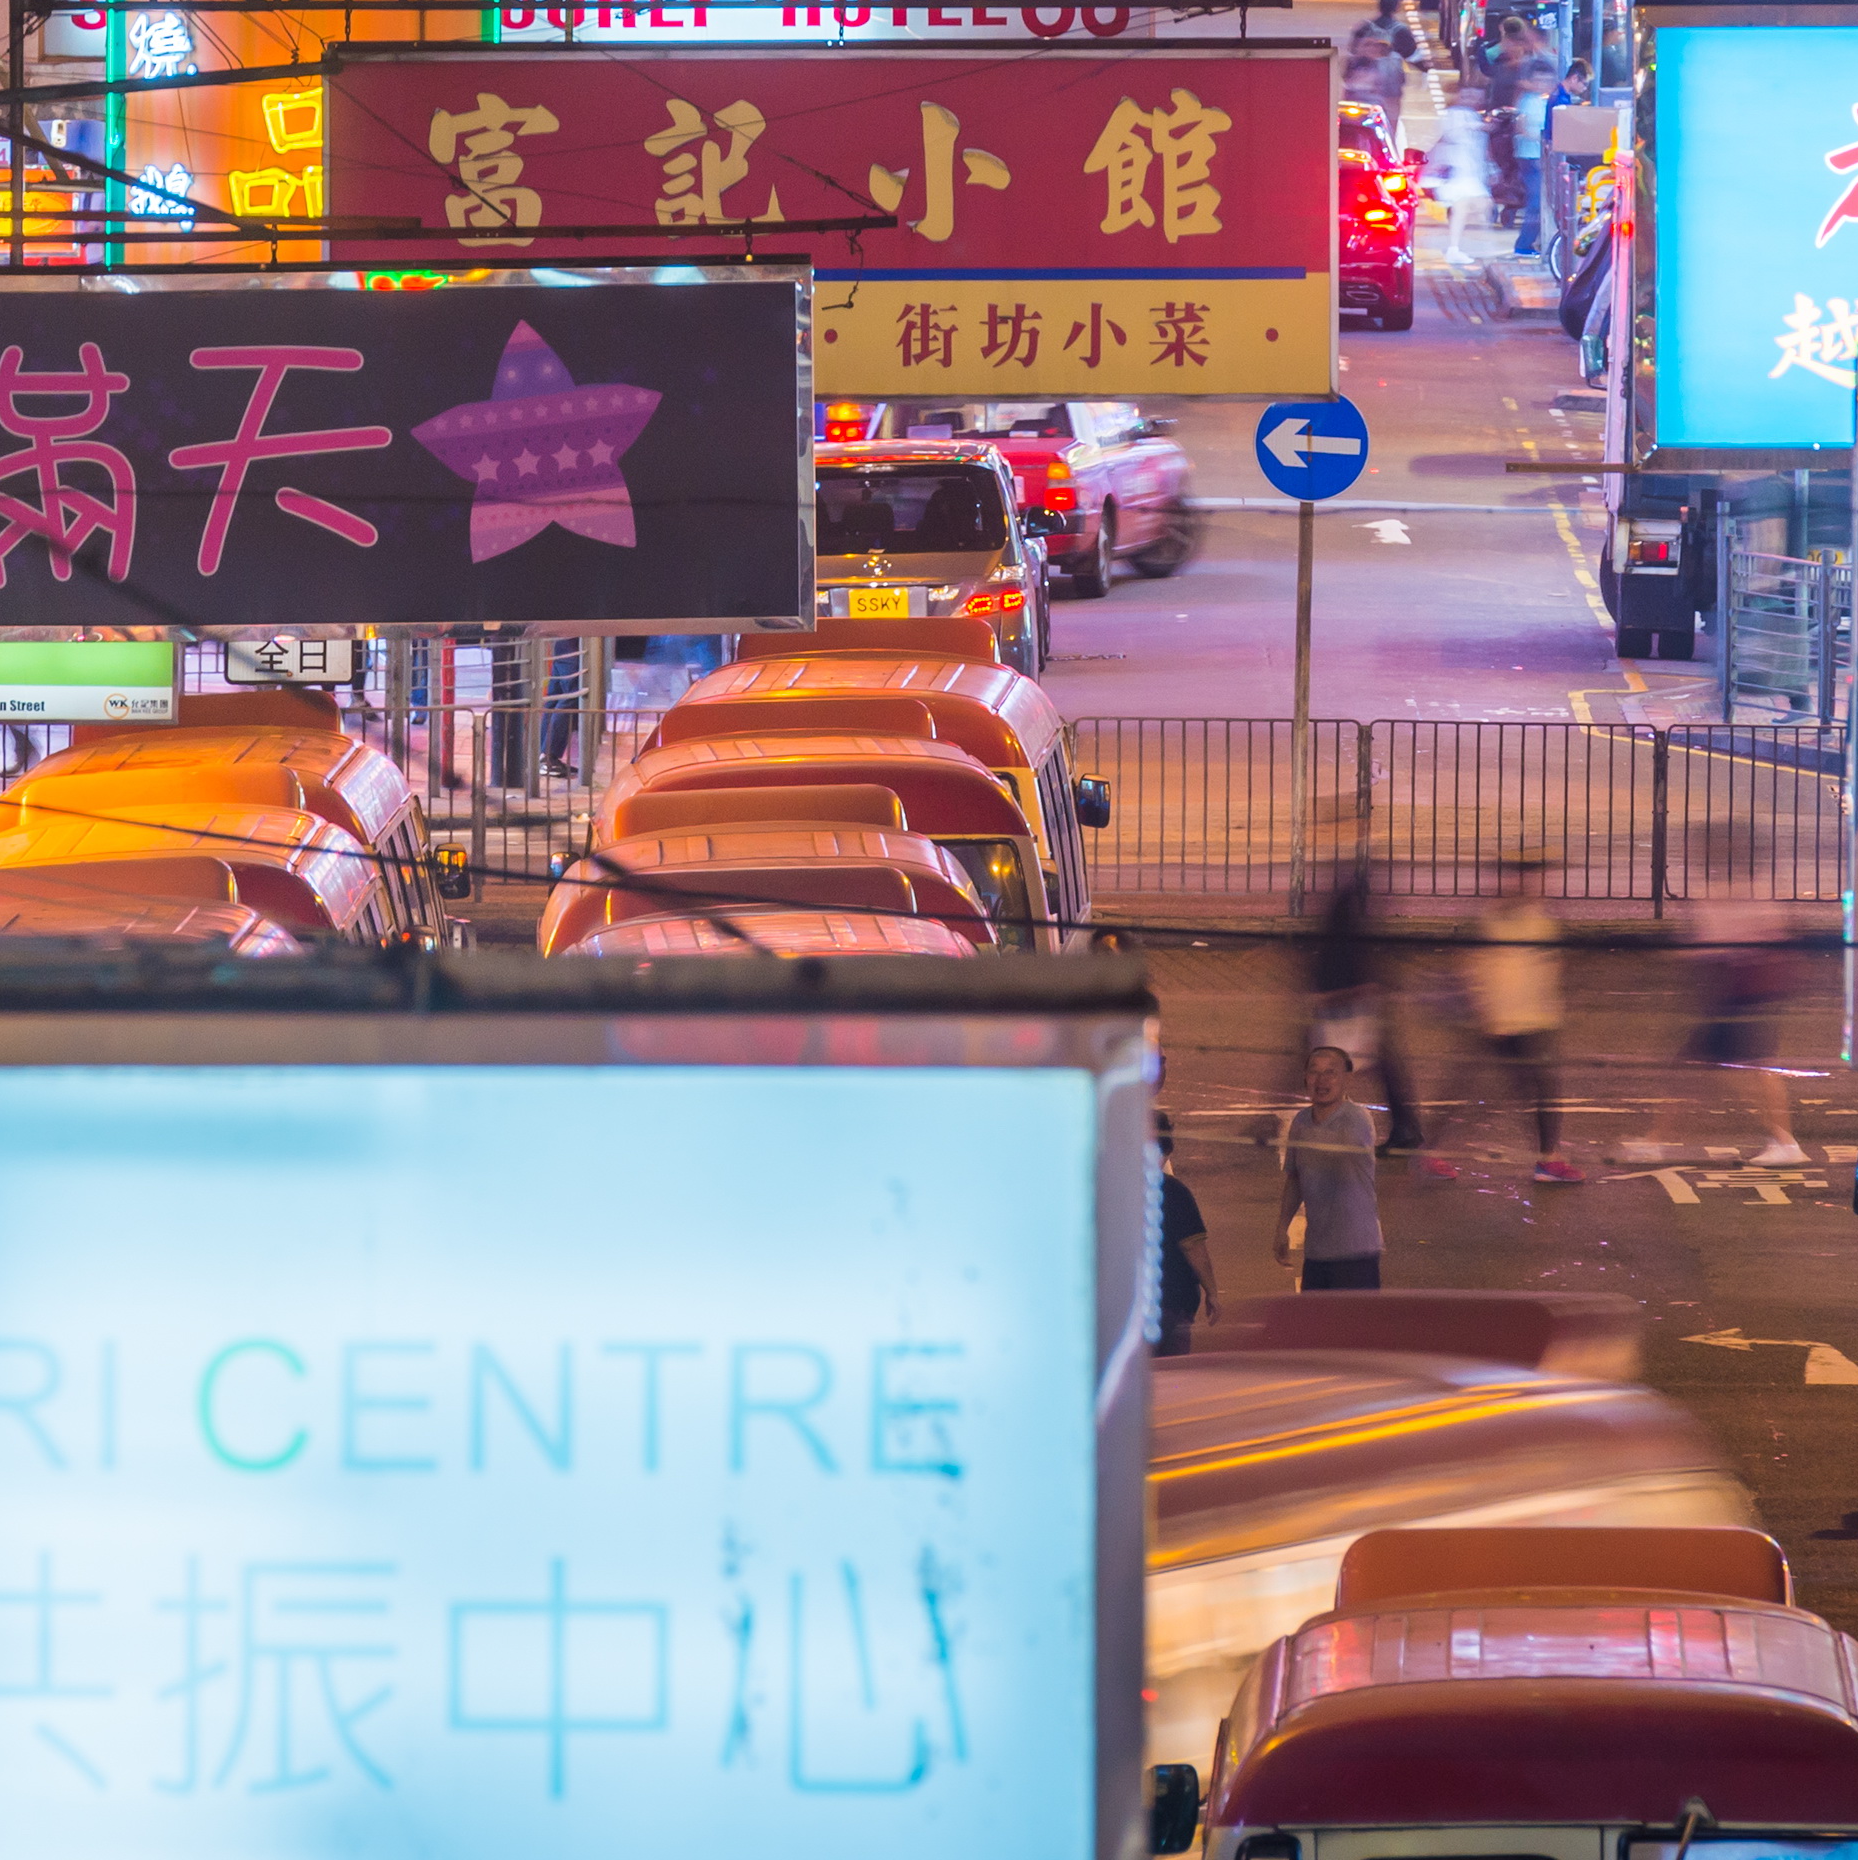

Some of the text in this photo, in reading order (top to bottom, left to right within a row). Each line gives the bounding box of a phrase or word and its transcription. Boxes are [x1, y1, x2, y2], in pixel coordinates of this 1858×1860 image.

[428, 88, 1234, 247] 富記小館
[895, 301, 1212, 369] 街坊小菜
[856, 596, 901, 613] SSKY
[254, 639, 327, 674] 全日
[9, 698, 46, 713] Street
[198, 1332, 971, 1476] CENTRE
